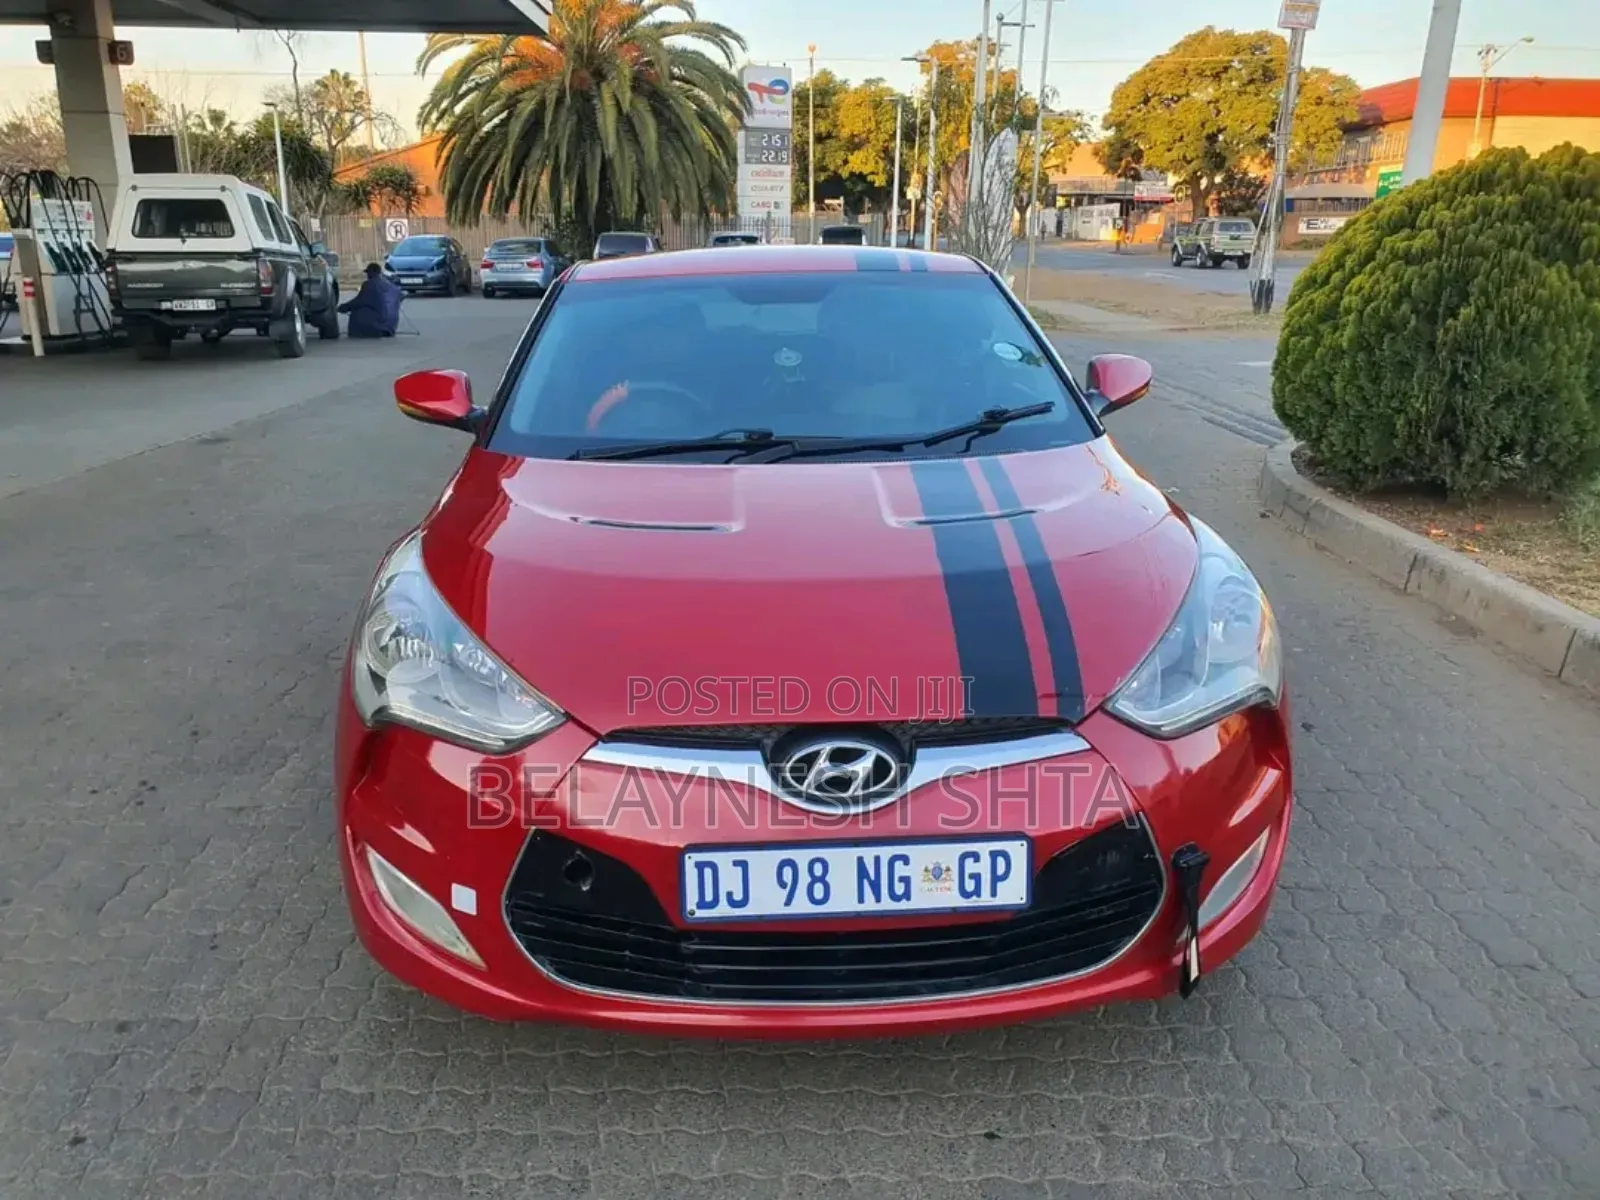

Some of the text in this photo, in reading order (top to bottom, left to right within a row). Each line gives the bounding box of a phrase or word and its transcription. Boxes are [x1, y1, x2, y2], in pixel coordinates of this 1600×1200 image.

[116, 44, 127, 61] 6
[694, 849, 1012, 910] DJ 98 NG GP
